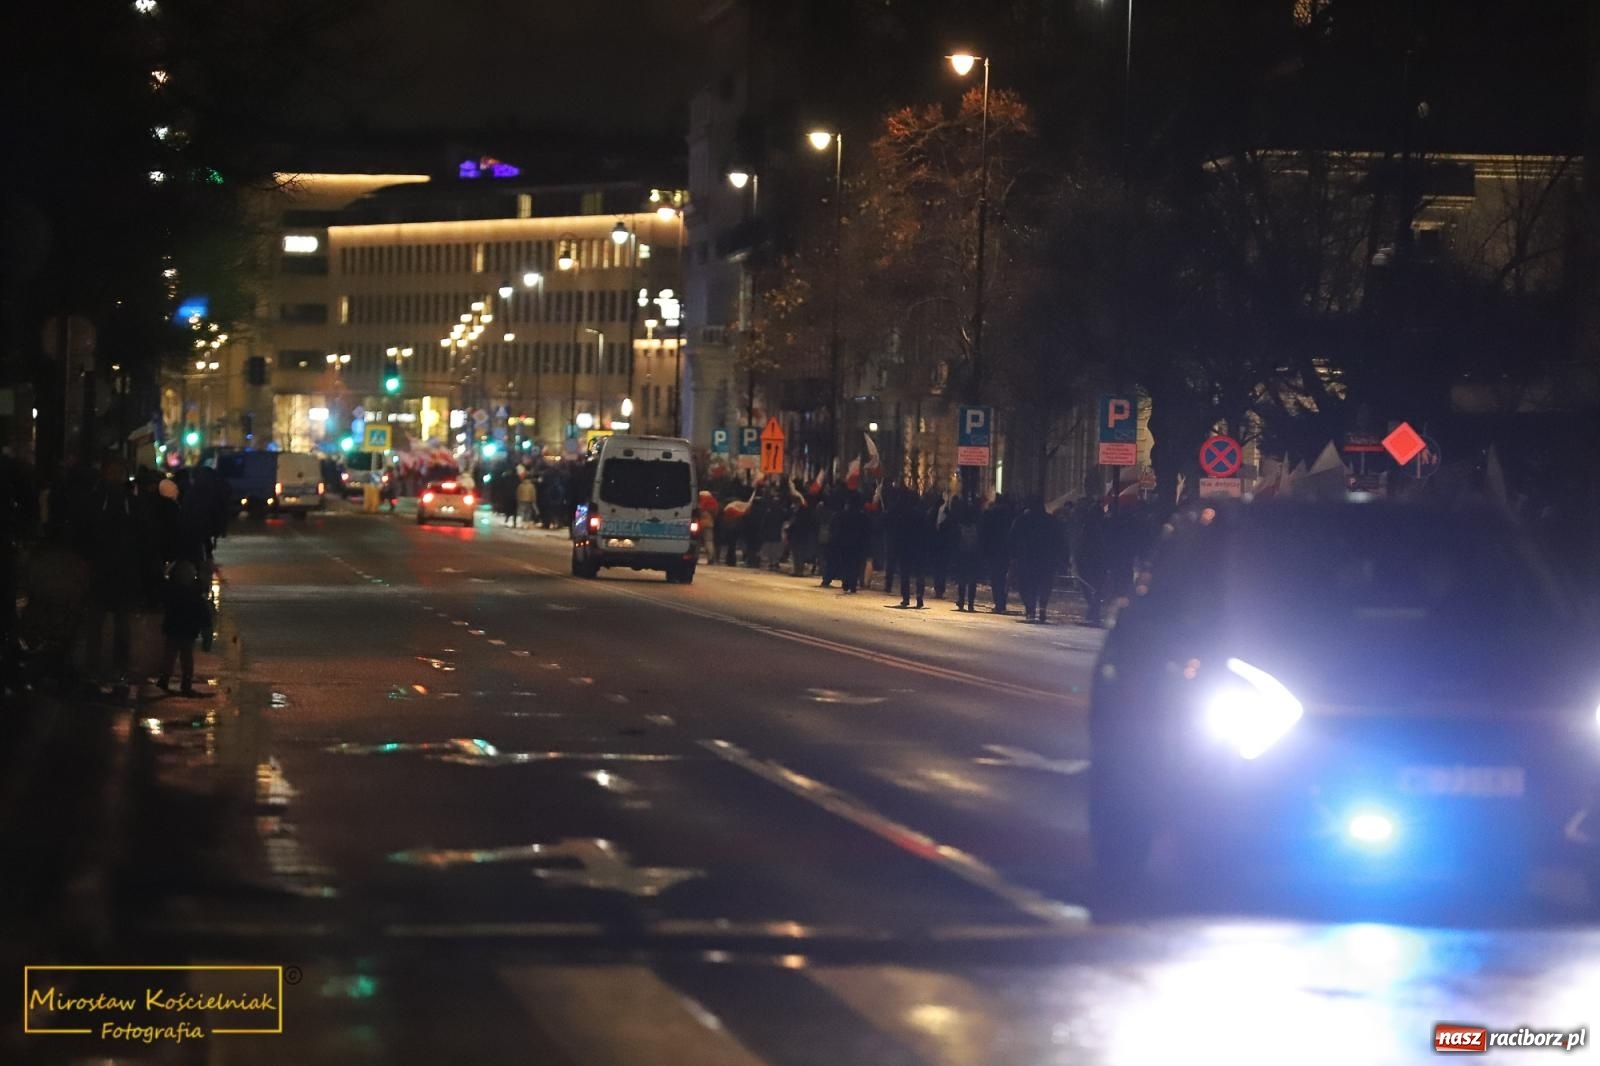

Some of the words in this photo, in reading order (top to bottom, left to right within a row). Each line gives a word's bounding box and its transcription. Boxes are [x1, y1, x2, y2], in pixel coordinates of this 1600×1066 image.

[965, 409, 985, 434] P
[1107, 398, 1130, 428] P
[714, 430, 727, 446] P
[743, 428, 758, 447] P
